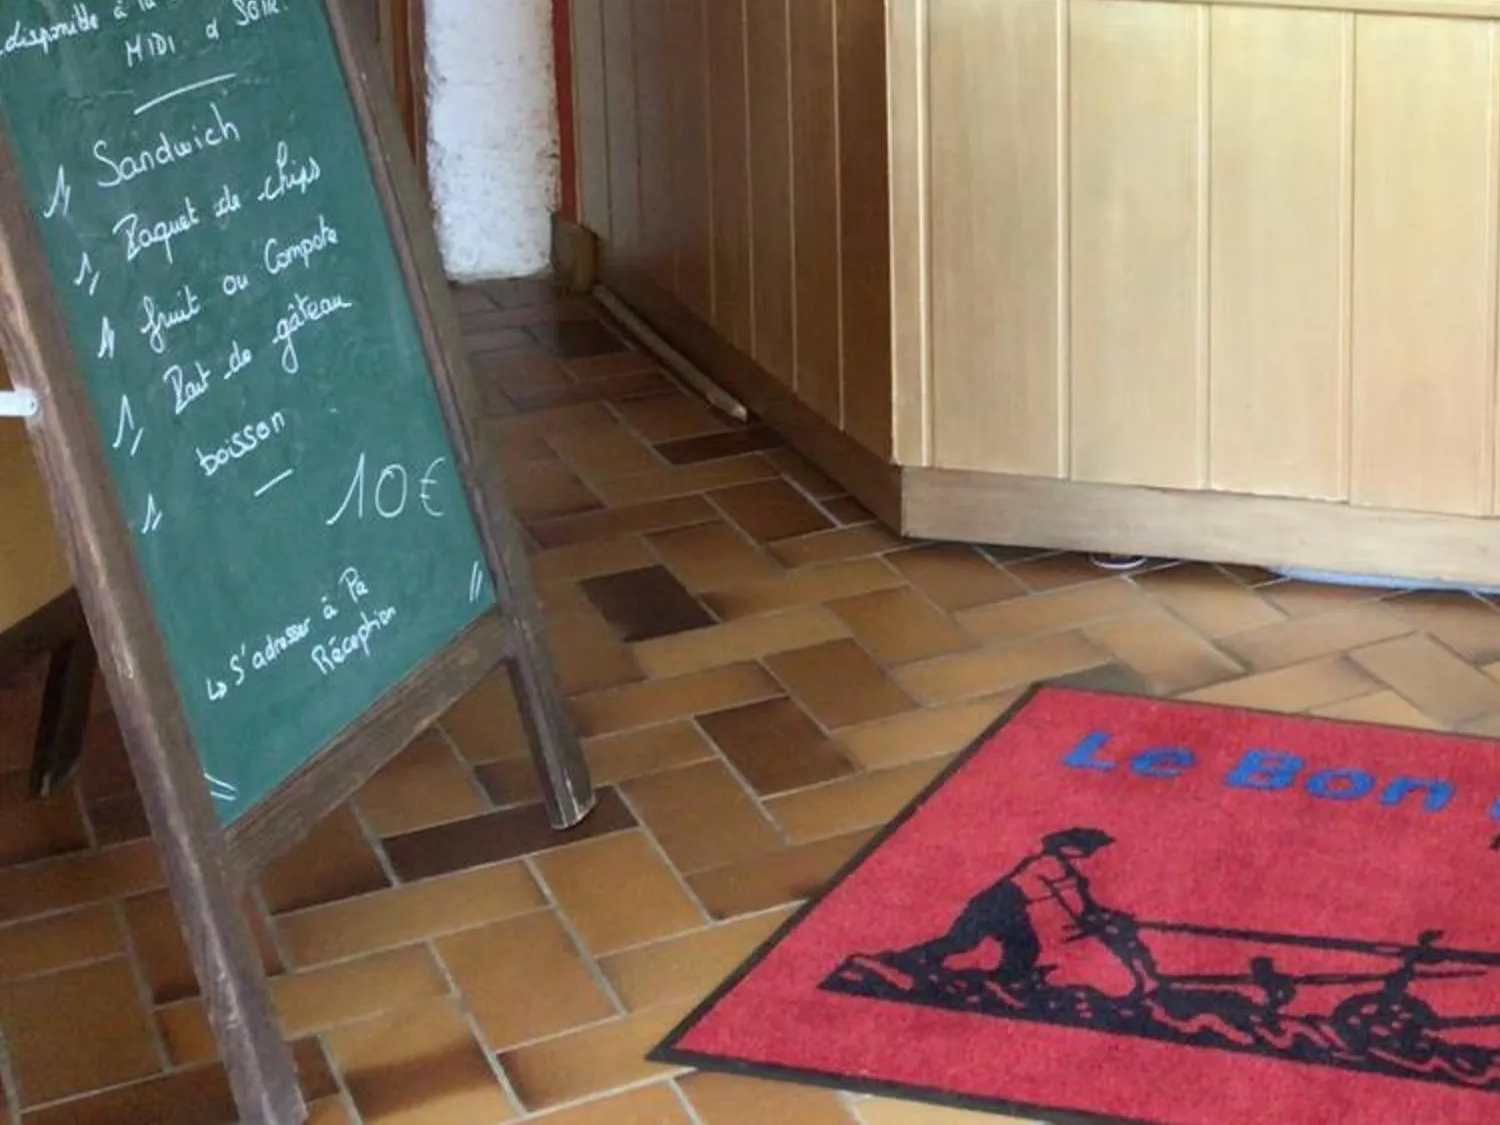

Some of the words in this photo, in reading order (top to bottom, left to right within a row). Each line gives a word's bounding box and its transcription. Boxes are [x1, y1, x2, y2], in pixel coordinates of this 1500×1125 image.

[124, 33, 176, 68] MIDI
[93, 102, 241, 188] Sandwich
[112, 196, 200, 264] Paquet
[215, 184, 241, 217] de
[222, 274, 249, 296] ou
[224, 340, 252, 379] de
[272, 293, 352, 374] gâteau
[196, 410, 285, 476] boisson
[312, 606, 396, 675] Réception
[321, 595, 338, 620] à
[1063, 731, 1195, 779] Le
[1224, 746, 1456, 814] Bon
